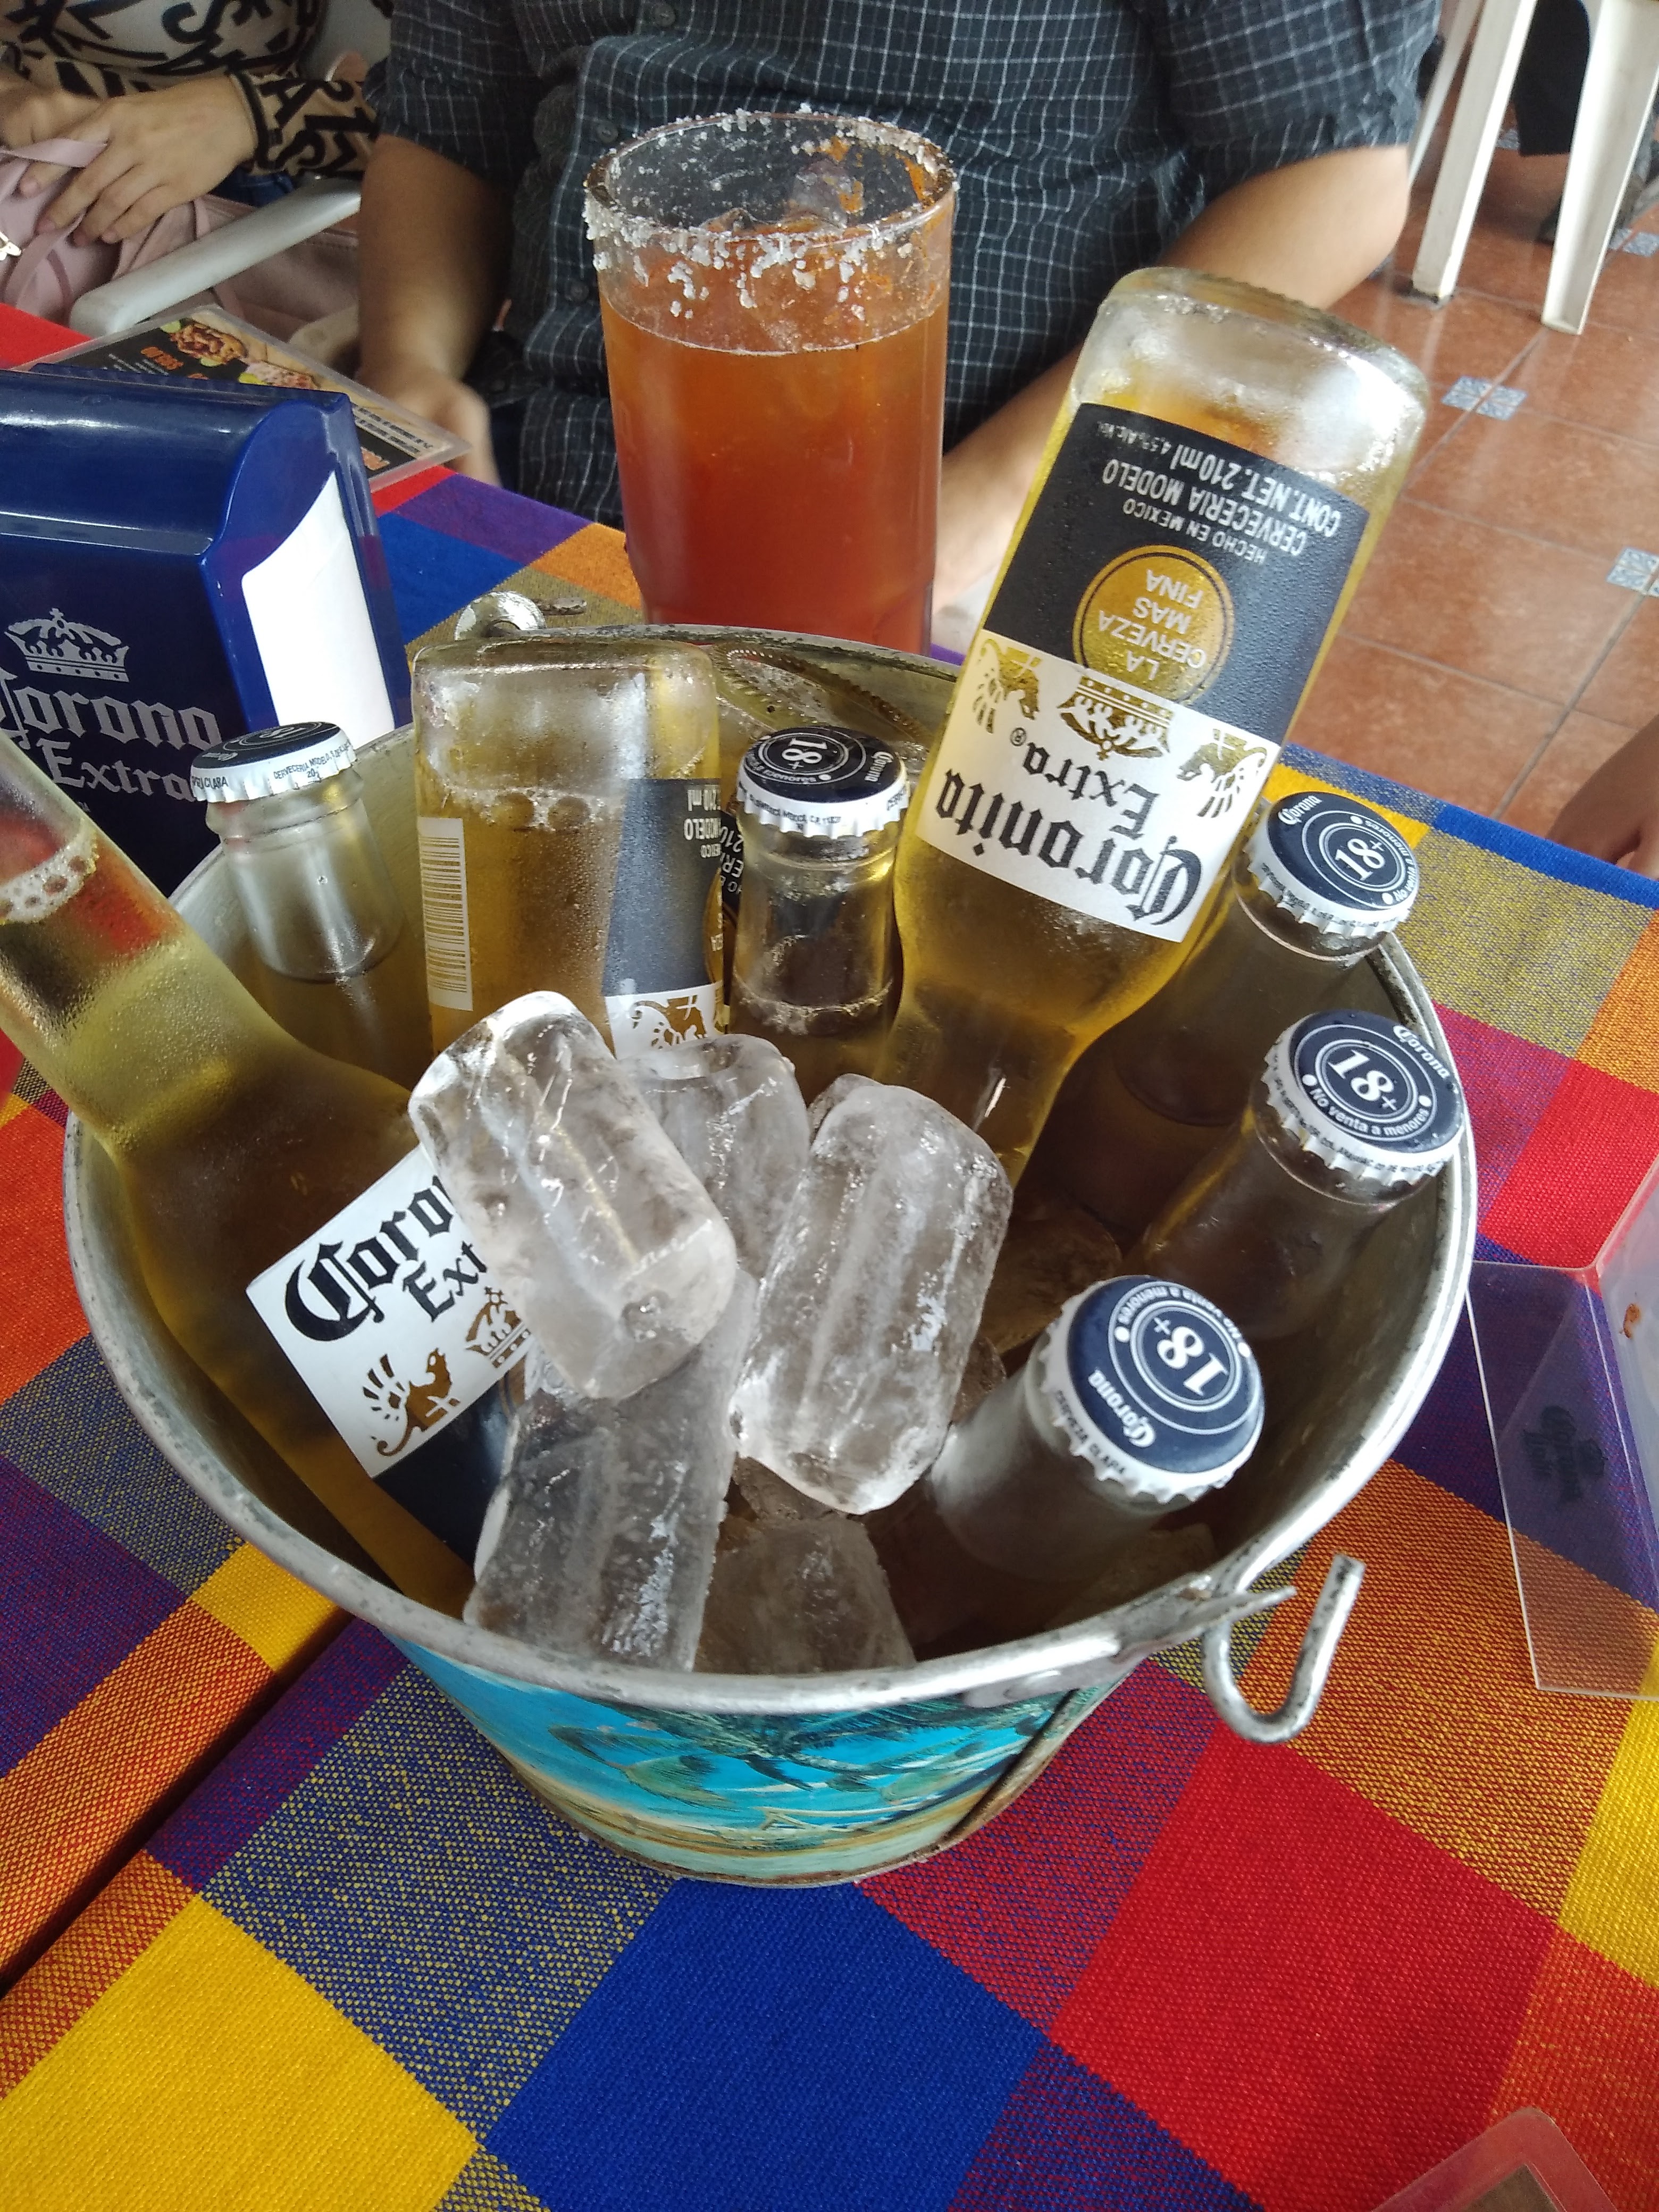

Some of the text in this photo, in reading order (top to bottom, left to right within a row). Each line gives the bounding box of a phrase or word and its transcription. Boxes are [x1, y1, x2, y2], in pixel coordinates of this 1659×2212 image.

[1102, 459, 1307, 556] CERVECERIA MODELO
[1122, 498, 1268, 565] HECHO EN MEXICO
[1133, 597, 1192, 634] MAS
[1146, 569, 1203, 609] FINA
[1099, 610, 1206, 668] CERVEZA
[1127, 650, 1159, 681] LA
[37, 738, 197, 802] Extra
[864, 751, 894, 782] Corona
[1022, 742, 1160, 840] Extra
[1277, 795, 1323, 825] Corona
[1365, 820, 1410, 857] menores
[935, 768, 1202, 926] Coronita
[1393, 1025, 1451, 1080] Corona
[1310, 1088, 1430, 1136] No venta a menores
[284, 1175, 455, 1342] Coro
[402, 1241, 488, 1323] Ext
[1088, 1369, 1157, 1448] Corona
